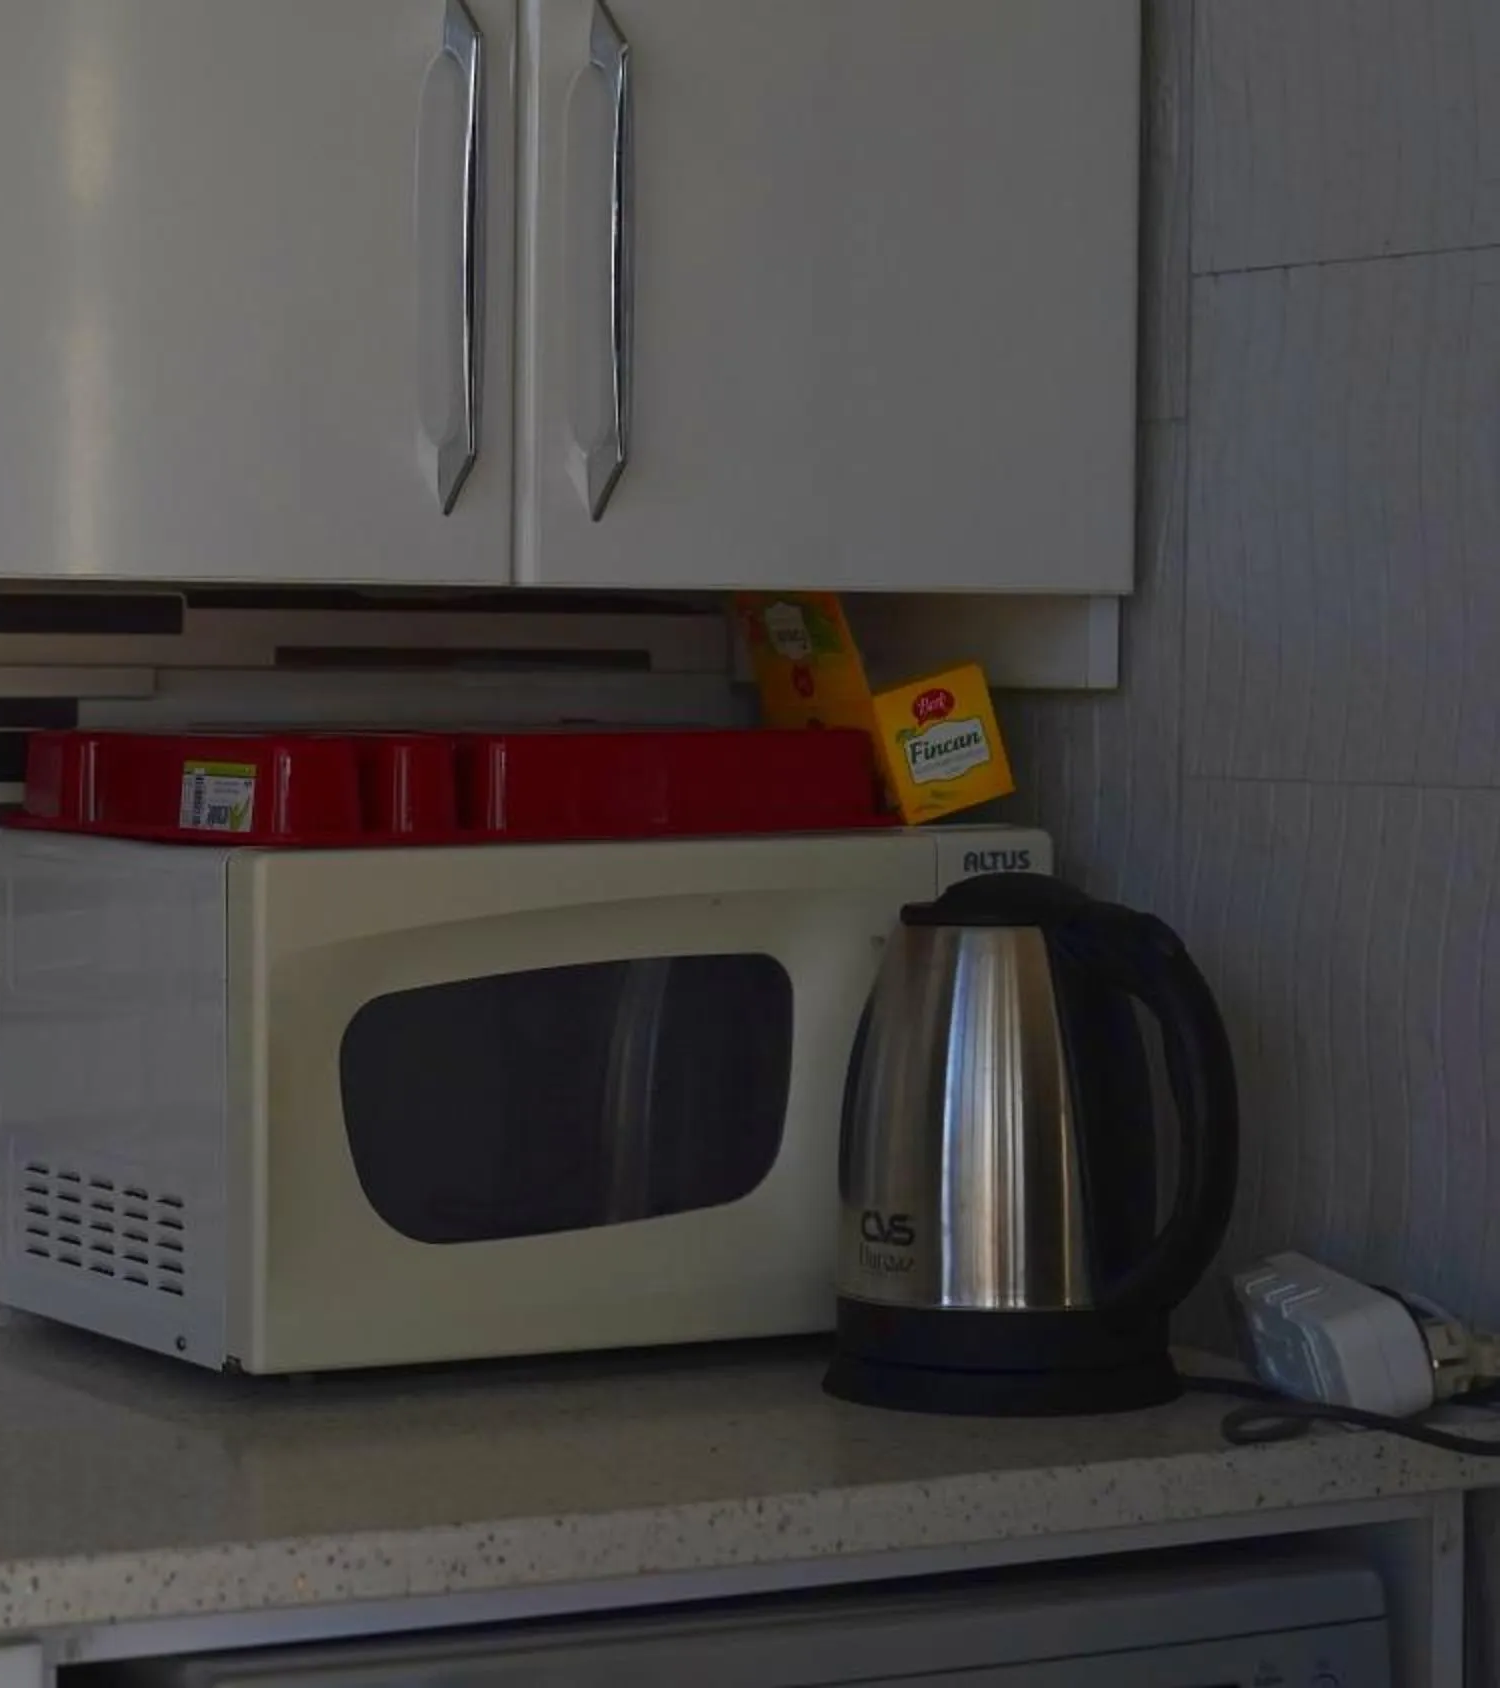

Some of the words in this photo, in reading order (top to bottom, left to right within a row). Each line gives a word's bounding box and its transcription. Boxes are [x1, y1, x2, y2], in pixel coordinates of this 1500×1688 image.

[909, 731, 981, 765] Fincan
[964, 849, 1031, 872] ALTUS
[861, 1209, 916, 1246] CVS
